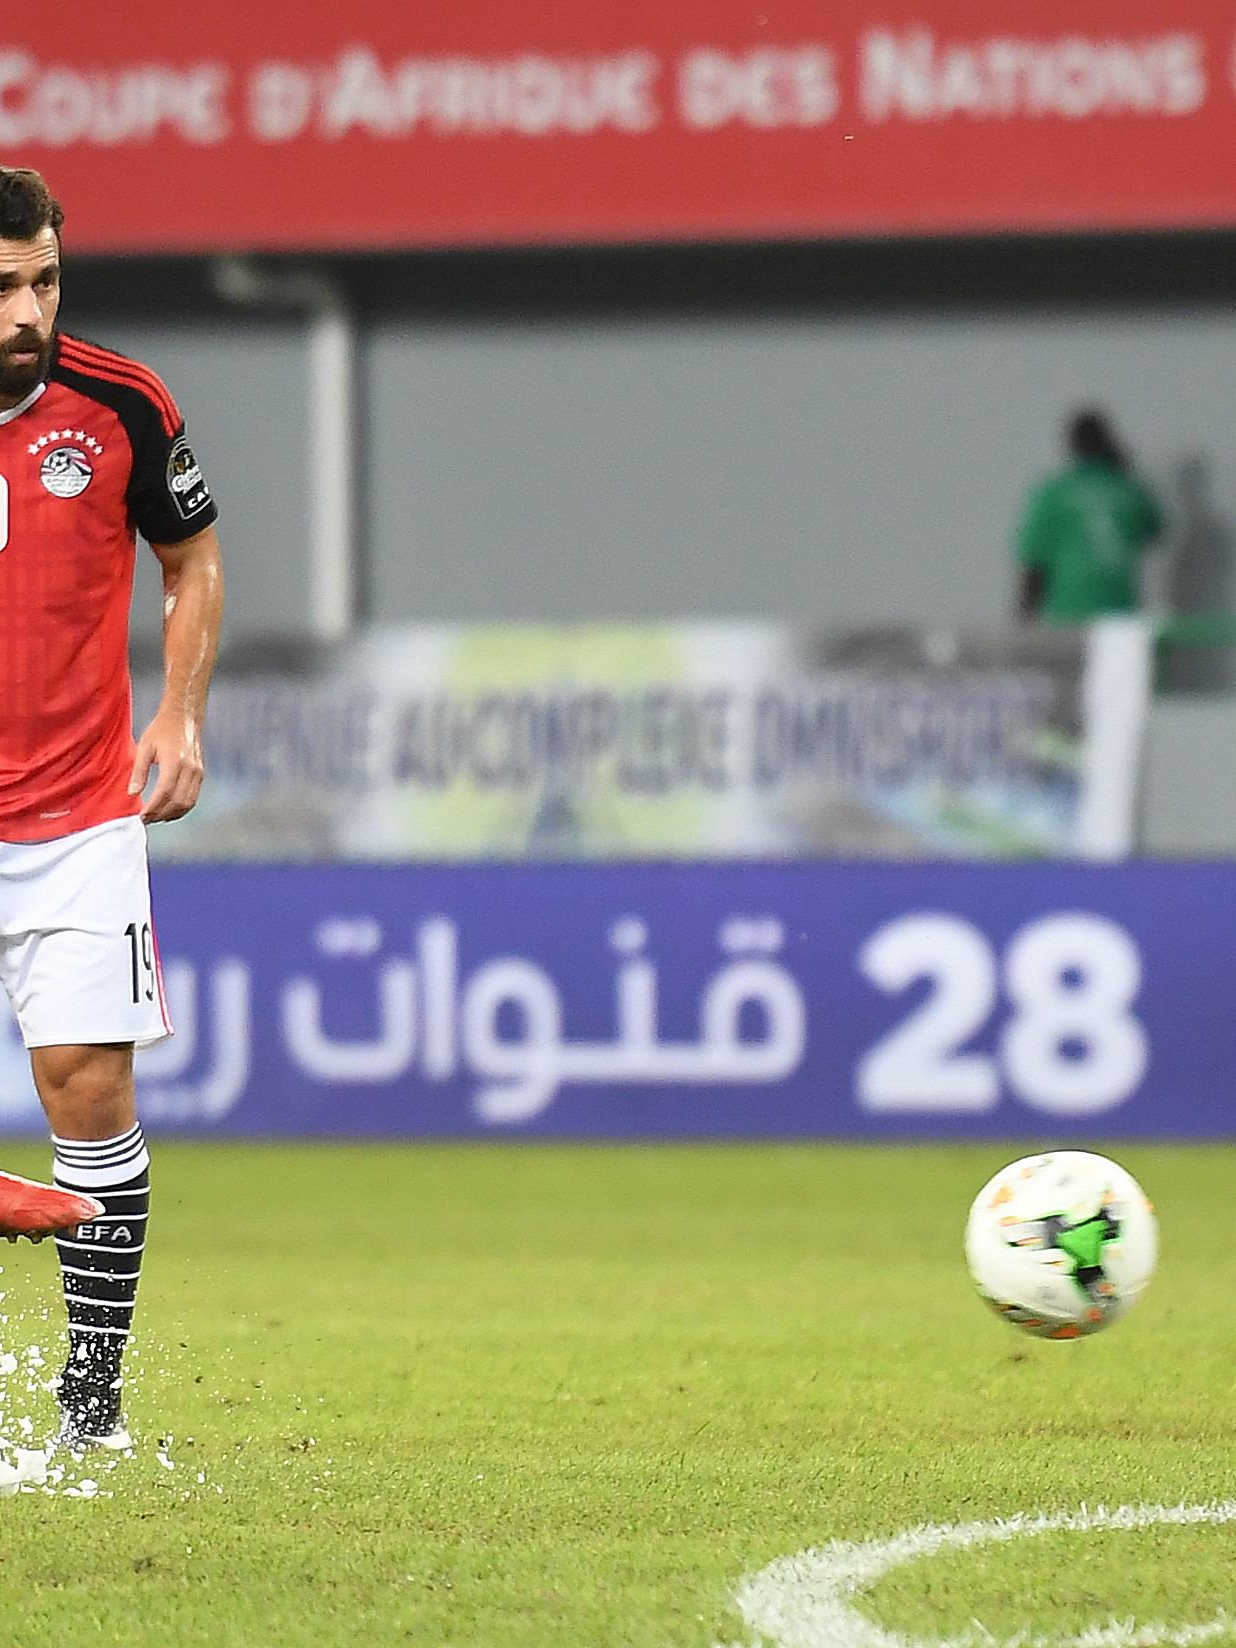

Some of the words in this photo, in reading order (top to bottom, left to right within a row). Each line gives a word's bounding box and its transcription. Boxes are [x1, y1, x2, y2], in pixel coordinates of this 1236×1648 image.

[677, 43, 841, 129] DES
[859, 27, 1207, 120] NATIONS
[124, 922, 154, 1004] 19
[857, 911, 1148, 1114] 28
[282, 914, 807, 1123] قنوات
[77, 1224, 132, 1243] EFA
